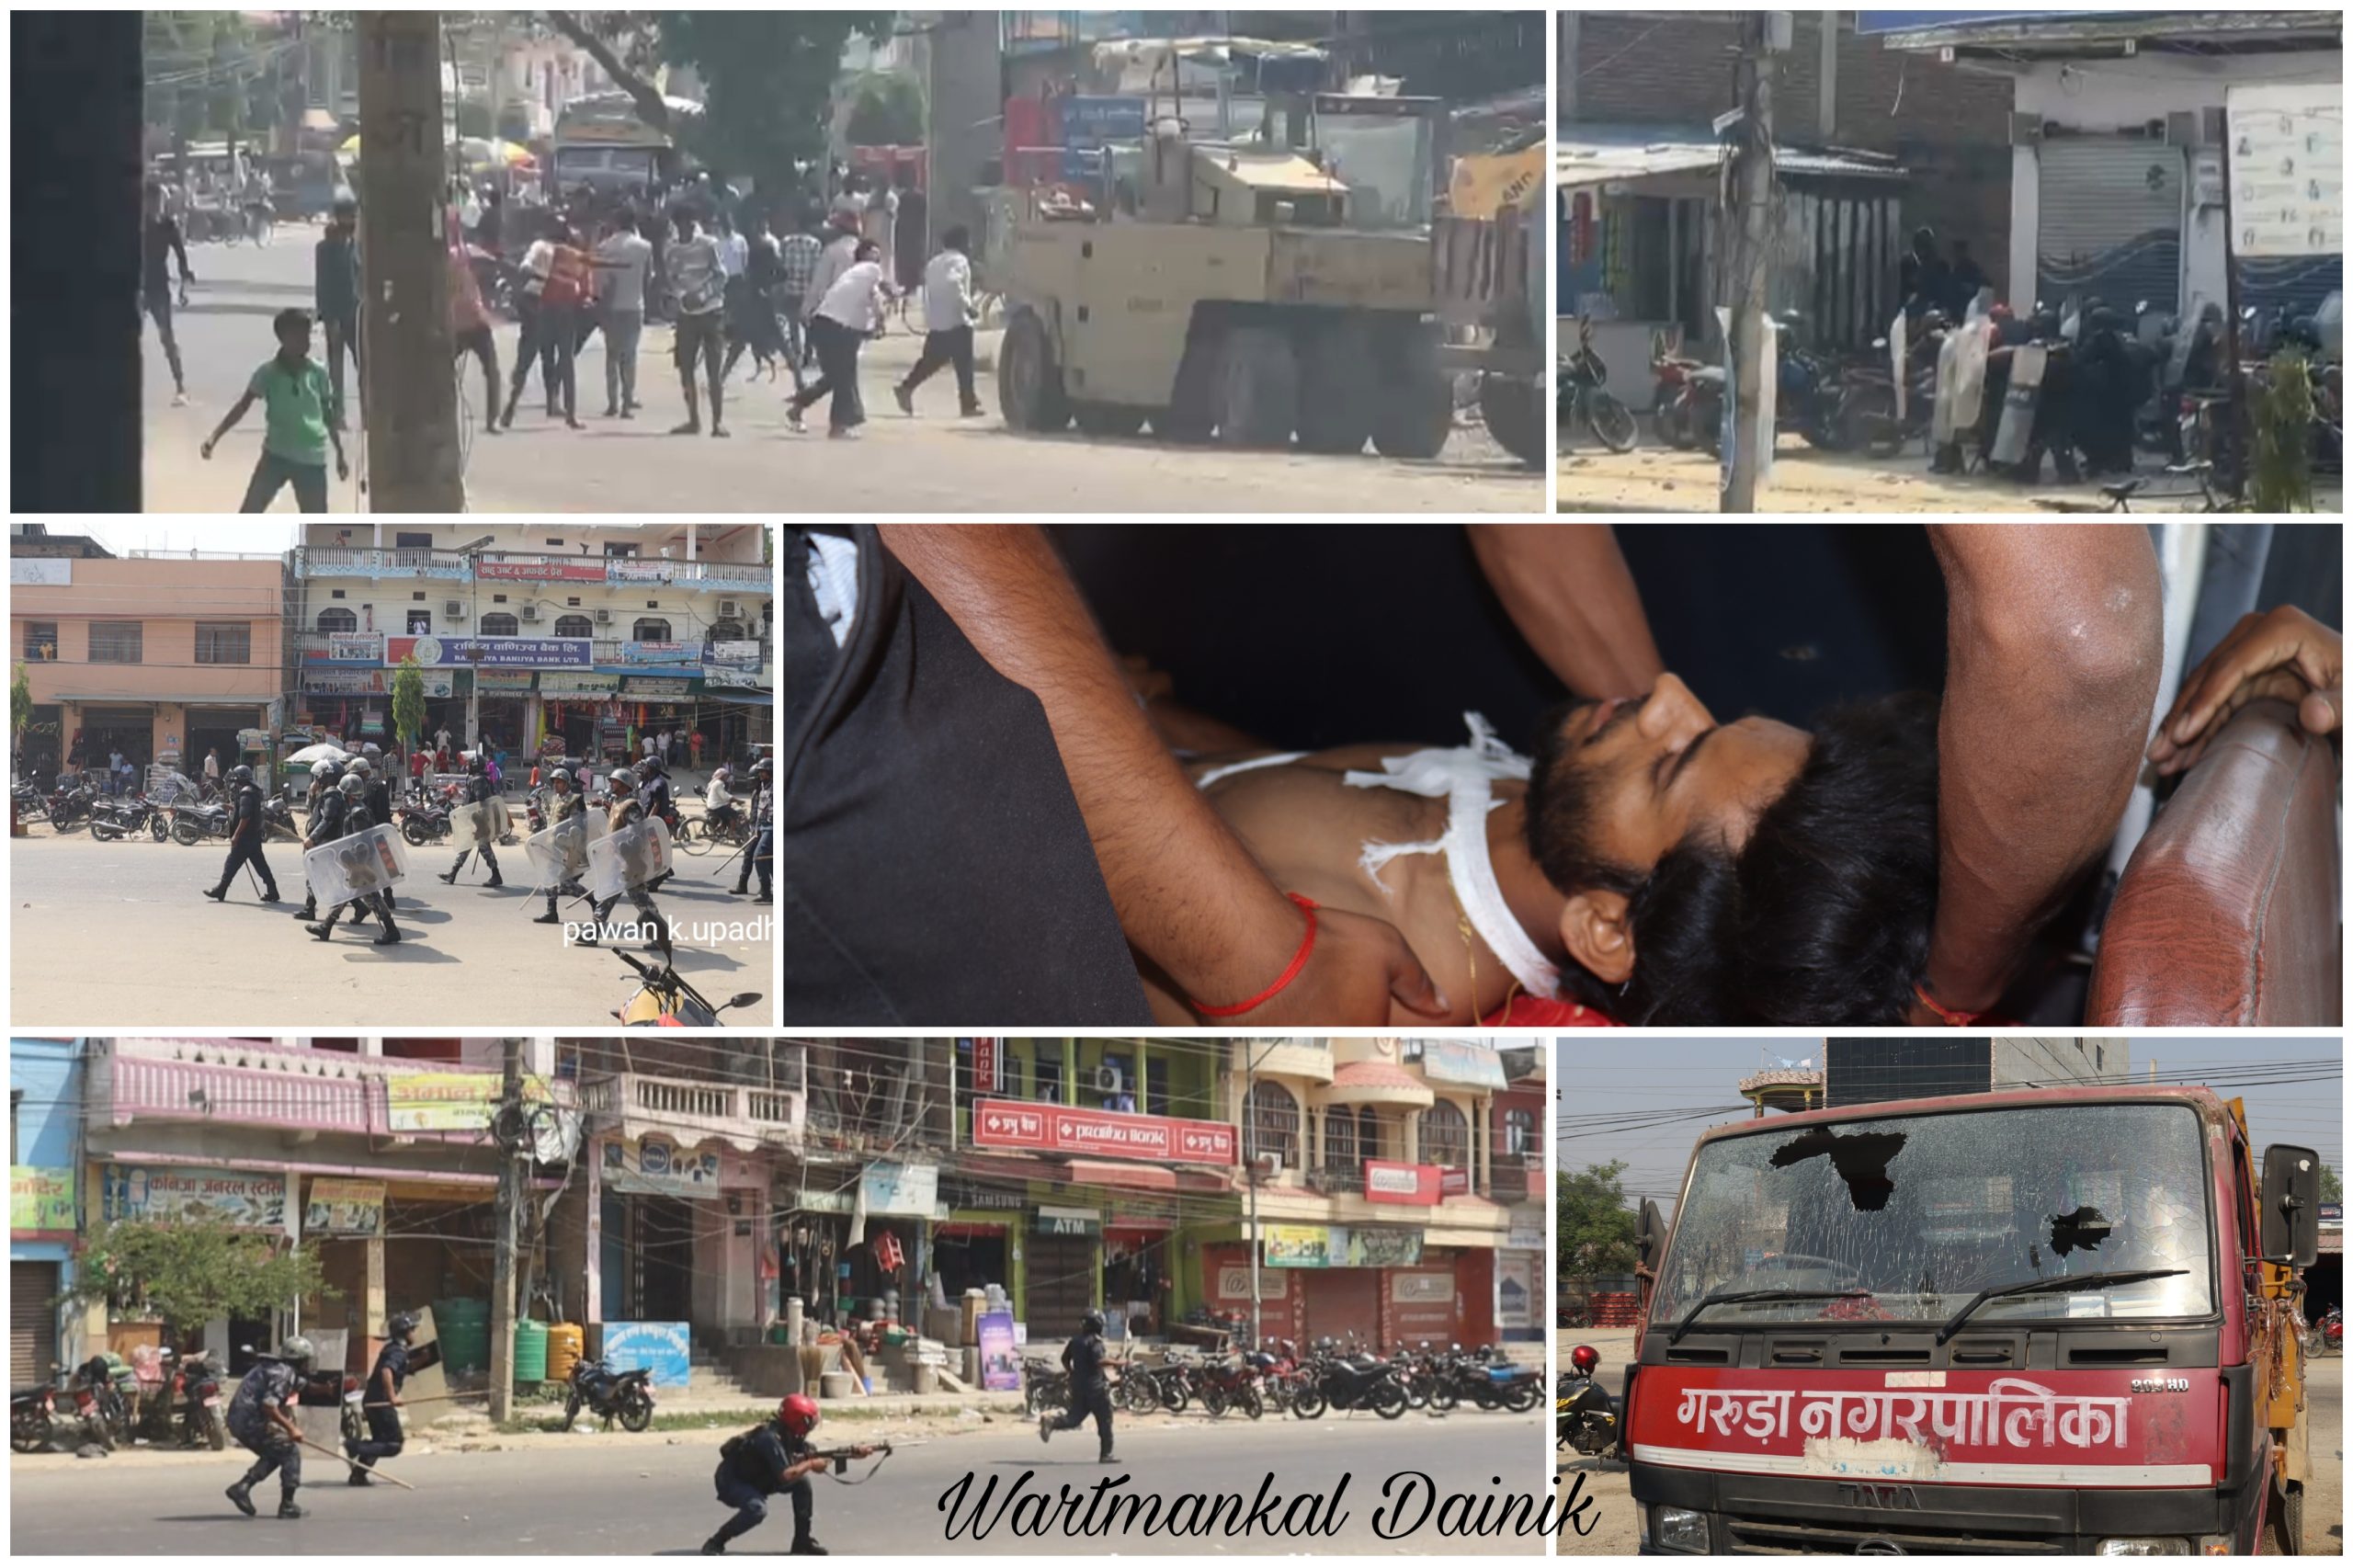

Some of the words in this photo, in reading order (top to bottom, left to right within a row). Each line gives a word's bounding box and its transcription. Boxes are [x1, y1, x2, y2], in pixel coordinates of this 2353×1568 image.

[972, 1194, 1021, 1209] SAMSUNG
[1053, 1219, 1086, 1234] ATM
[2166, 1378, 2189, 1392] HD
[1801, 1377, 2132, 1449] नगरपालिका
[1837, 1483, 1922, 1510] TATA
